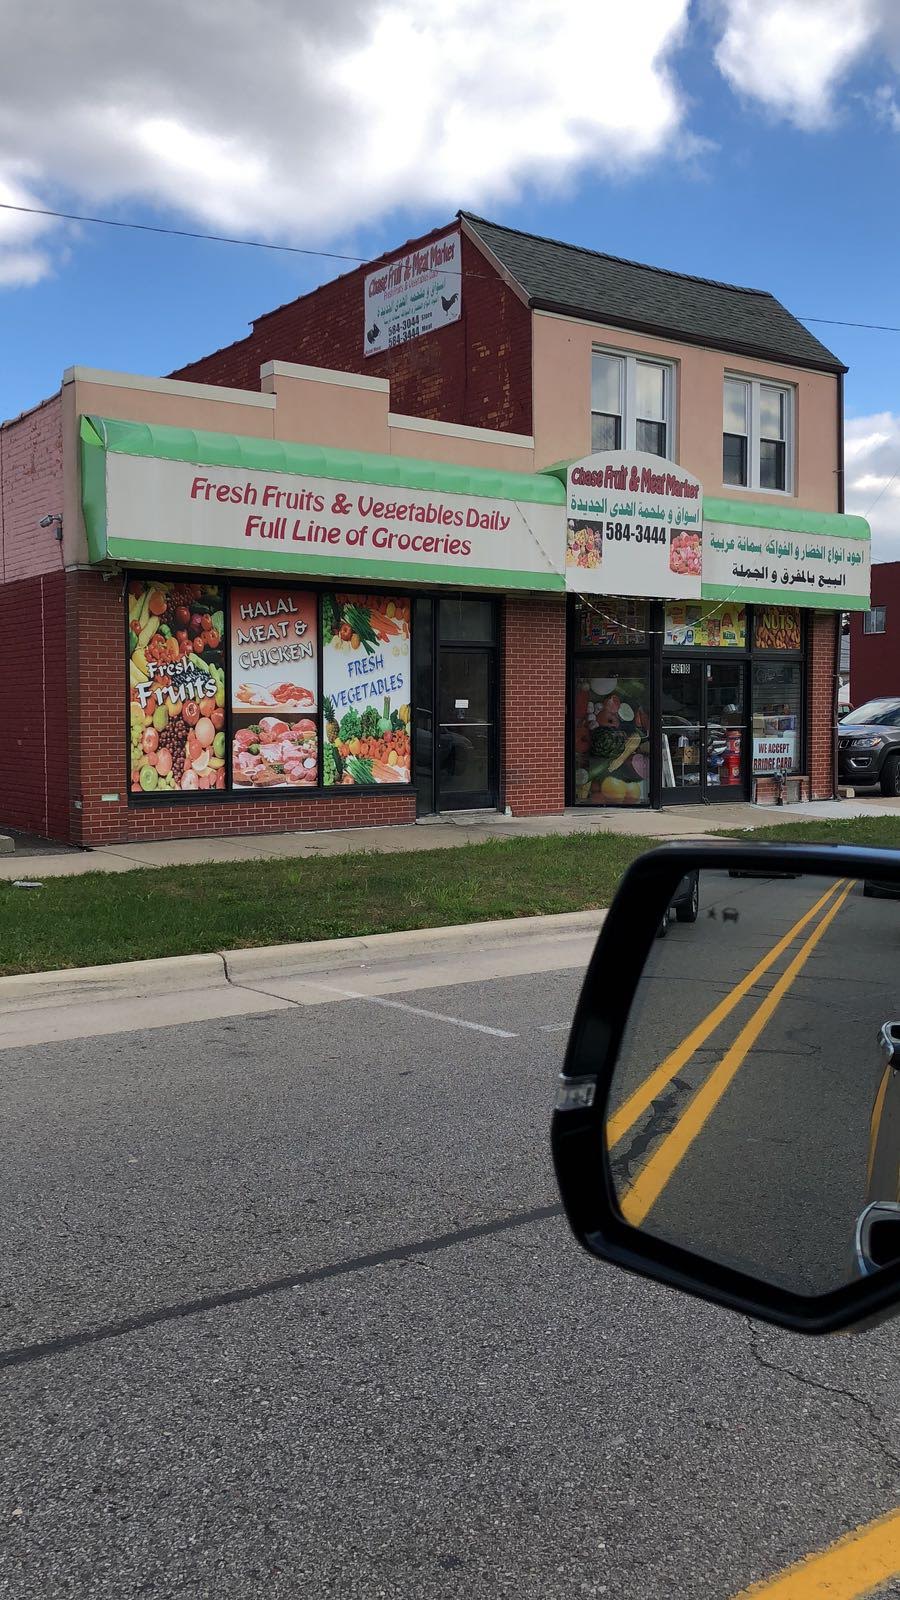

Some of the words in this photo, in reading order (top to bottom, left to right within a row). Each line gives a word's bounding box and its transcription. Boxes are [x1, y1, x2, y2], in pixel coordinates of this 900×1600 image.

[403, 256, 412, 281] &
[430, 242, 455, 268] Market
[388, 315, 419, 337] 584-3044
[571, 466, 603, 488] Chase
[604, 465, 628, 491] Fruit
[629, 466, 640, 492] &
[640, 467, 666, 495] Meat
[666, 473, 700, 499] Market
[190, 477, 257, 504] Fresh
[262, 485, 325, 512] Fruits
[331, 493, 353, 515] &
[358, 496, 464, 527] Vegetables
[466, 508, 511, 531] Daily
[245, 515, 287, 540] Full
[292, 519, 341, 544] Line
[345, 525, 368, 548] of
[371, 527, 472, 556] Groceries
[605, 521, 667, 545] 584-3444
[239, 597, 298, 620] HALAL
[236, 621, 289, 646] MEAT
[293, 620, 308, 636] &
[762, 614, 794, 631] NUTS
[145, 655, 196, 679] Fresh
[238, 641, 314, 671] CHICKEN
[347, 654, 385, 679] FRESH
[134, 673, 218, 709] Fruits
[330, 672, 405, 709] VEGETABLES
[758, 743, 767, 754] WE
[768, 743, 790, 754] ACCEPT
[776, 756, 792, 770] CARD
